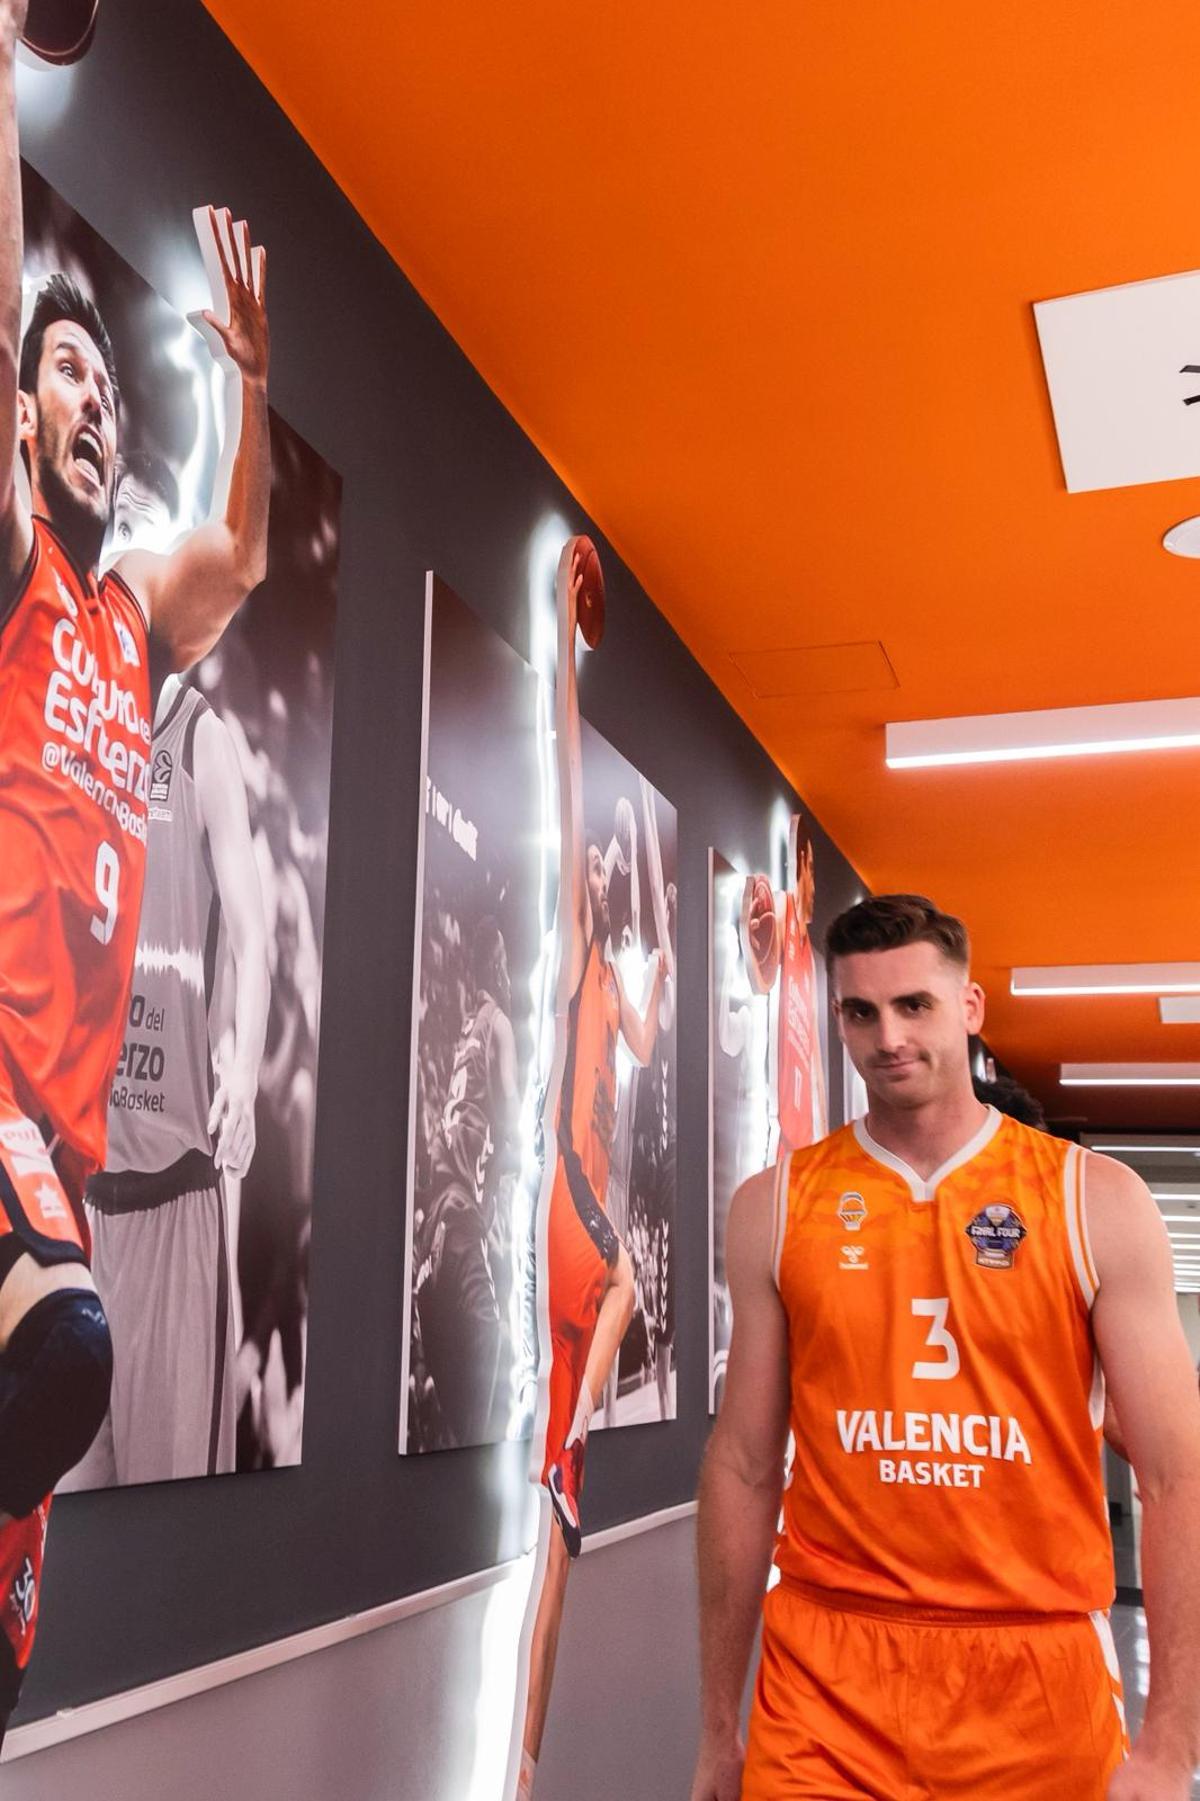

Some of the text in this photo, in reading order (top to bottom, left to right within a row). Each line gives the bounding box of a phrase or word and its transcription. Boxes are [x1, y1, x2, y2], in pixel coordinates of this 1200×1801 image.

[90, 841, 120, 945] 9
[145, 1008, 165, 1032] del
[997, 1227, 1020, 1238] FOUR
[911, 1298, 960, 1380] 3
[836, 1410, 1032, 1464] VALENCIA
[879, 1459, 985, 1488] BASKET
